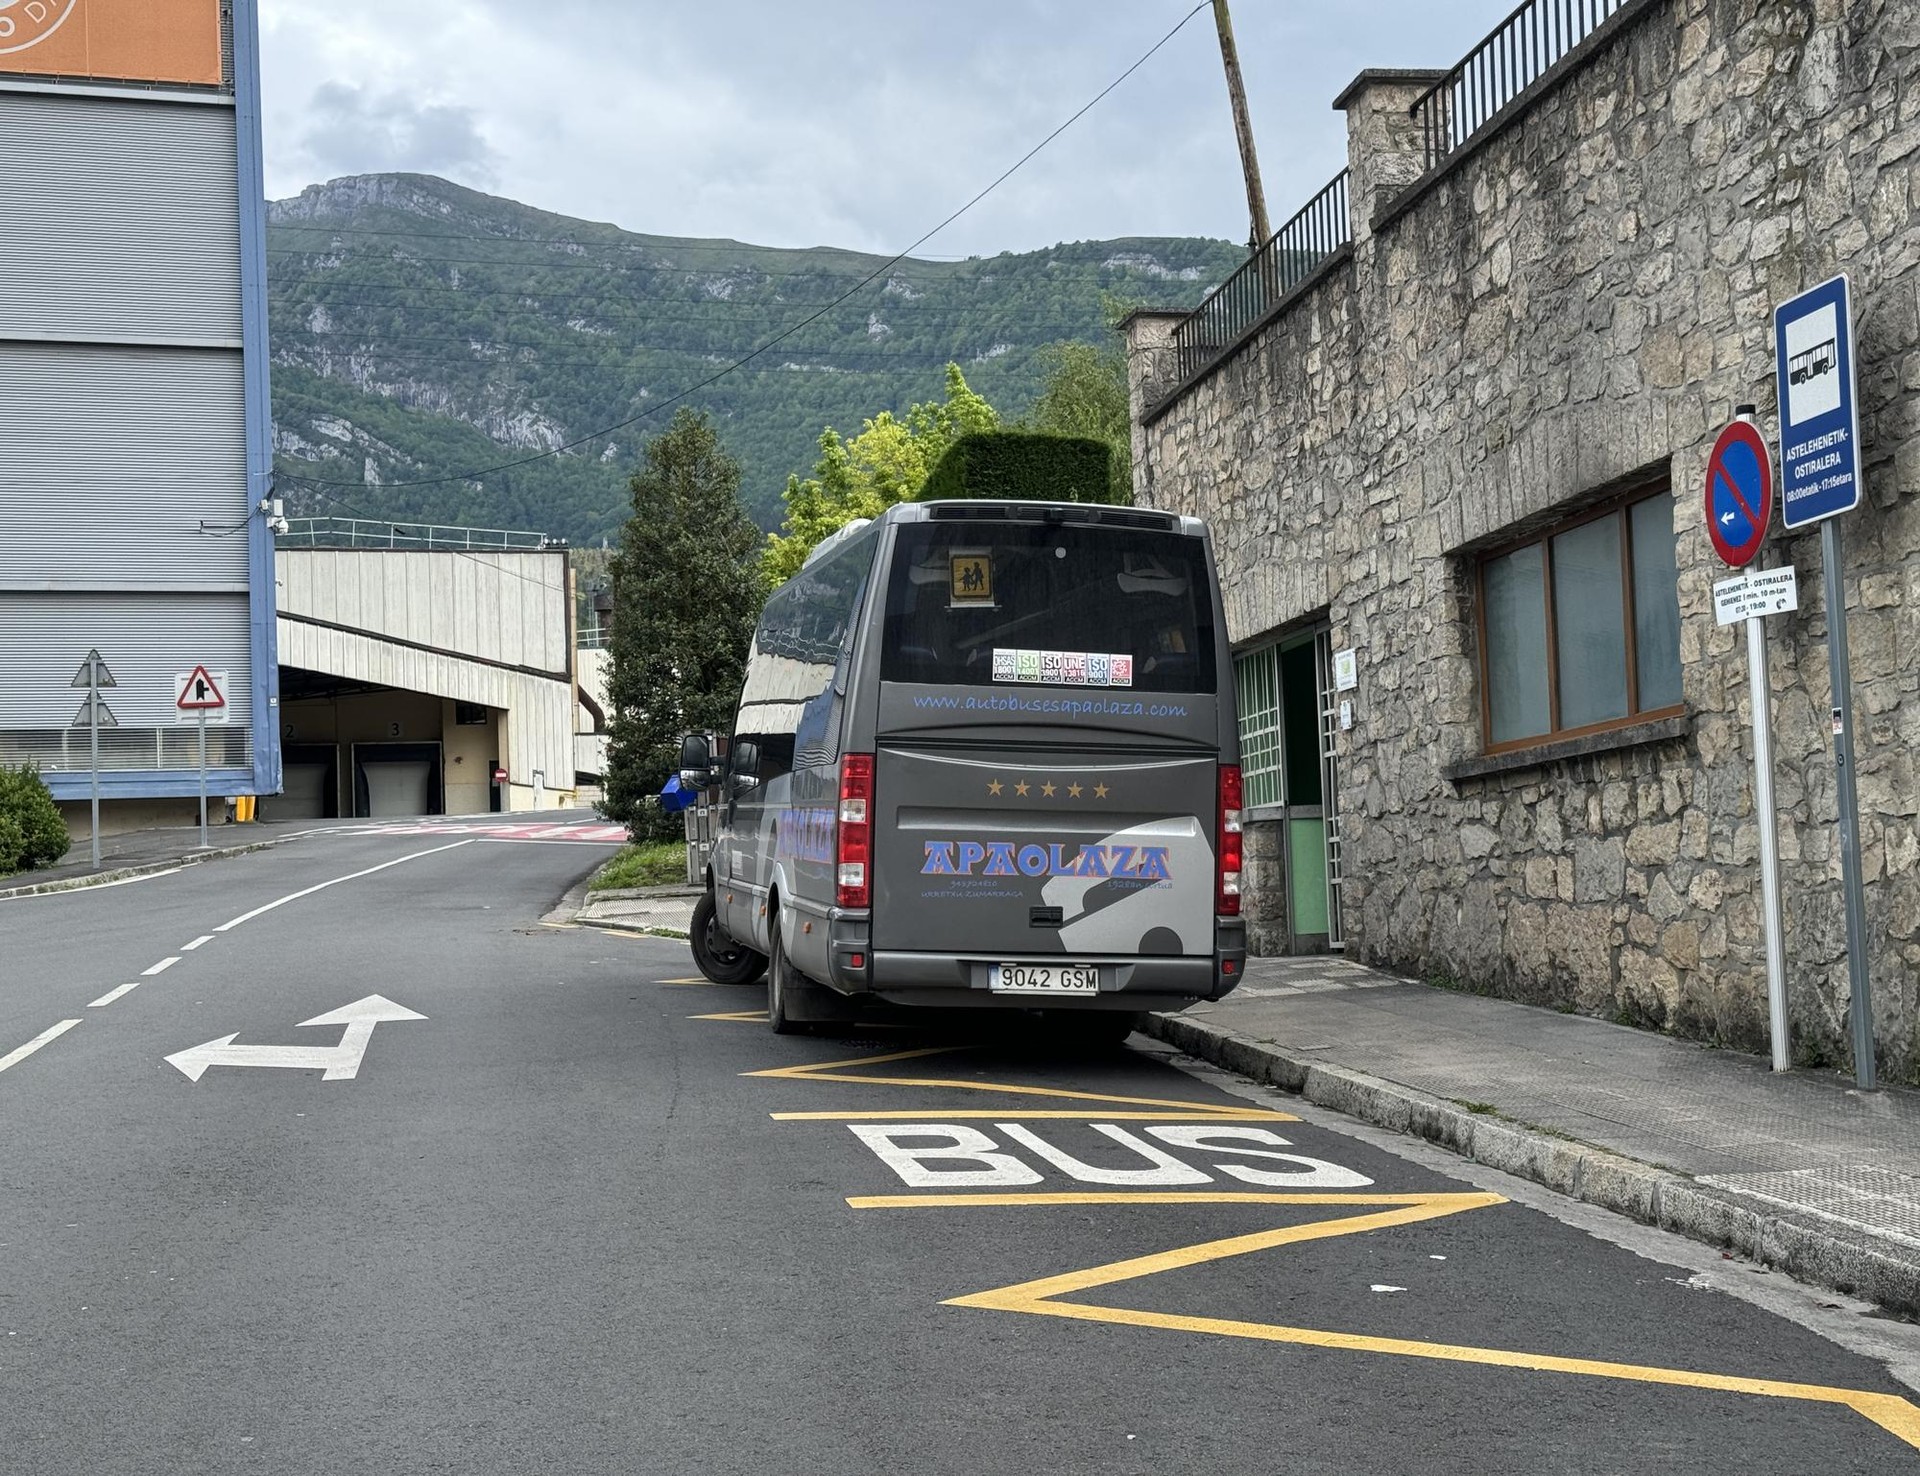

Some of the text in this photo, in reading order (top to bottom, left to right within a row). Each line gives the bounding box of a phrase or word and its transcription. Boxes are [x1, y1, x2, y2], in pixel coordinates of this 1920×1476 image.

[1794, 451, 1842, 479] OSTIRALERA
[1753, 574, 1793, 587] OSTIRALERA
[1760, 589, 1768, 597] 10
[1749, 601, 1767, 610] 19:00
[1018, 655, 1038, 668] ISO
[1041, 656, 1061, 669] ISO
[1064, 658, 1085, 669] UNE
[1088, 659, 1108, 671] ISO
[1088, 670, 1107, 678] 9001
[914, 694, 1188, 719] www.autobusesapaolaza.com
[285, 724, 294, 738] 2
[391, 723, 400, 736] 3
[920, 840, 1173, 879] APAOLAZA
[1002, 968, 1097, 989] 9042 GSM
[846, 1123, 1375, 1188] BUS
